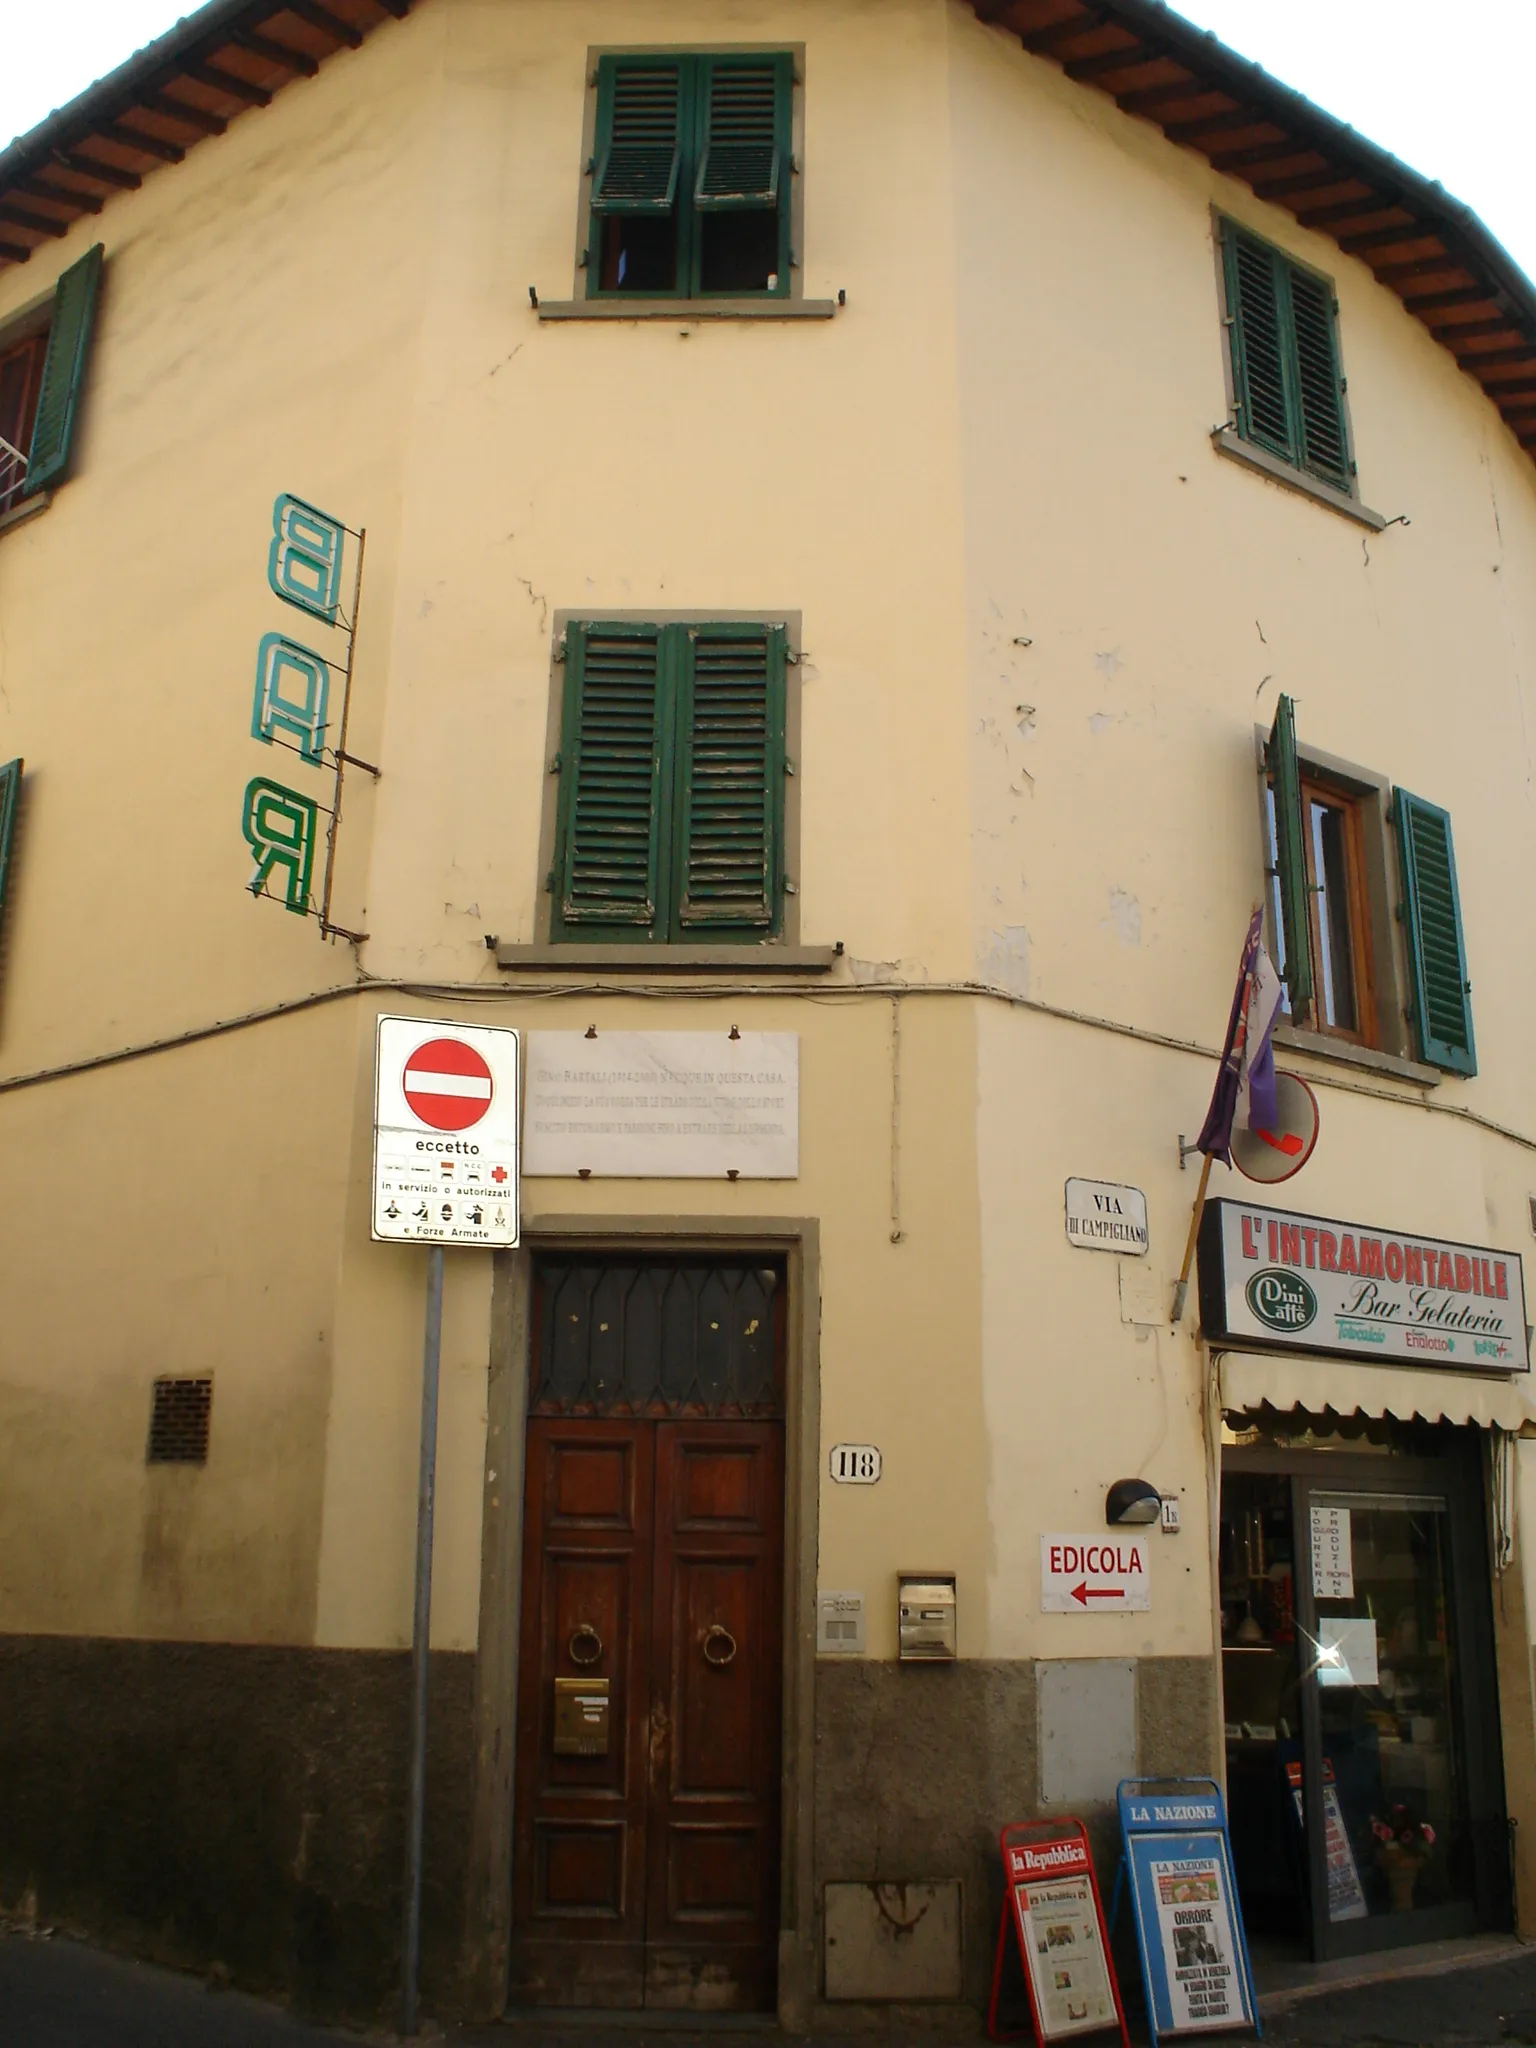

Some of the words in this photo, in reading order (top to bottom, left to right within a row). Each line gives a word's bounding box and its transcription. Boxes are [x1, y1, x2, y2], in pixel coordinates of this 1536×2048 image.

[415, 1140, 479, 1155] eccetto
[381, 1181, 392, 1190] in
[398, 1184, 438, 1193] servizio
[456, 1188, 511, 1198] autorizzati
[1093, 1194, 1123, 1215] VIA
[416, 1226, 444, 1235] Forze
[451, 1228, 489, 1238] Armate
[1068, 1217, 1079, 1234] DI
[1082, 1218, 1147, 1243] CAMPIGLIANO
[1341, 1279, 1401, 1317] Bar
[1408, 1287, 1503, 1333] Gelateria
[838, 1451, 875, 1478] 118
[1050, 1545, 1143, 1575] EDICOLA
[1130, 1807, 1151, 1821] LA
[1155, 1805, 1217, 1821] NAZIONE
[1011, 1852, 1026, 1871] la
[1025, 1844, 1086, 1872] Repubblica
[1156, 1863, 1170, 1873] LA
[1173, 1859, 1214, 1872] NAZIONE
[1174, 1908, 1213, 1926] ORRORE
